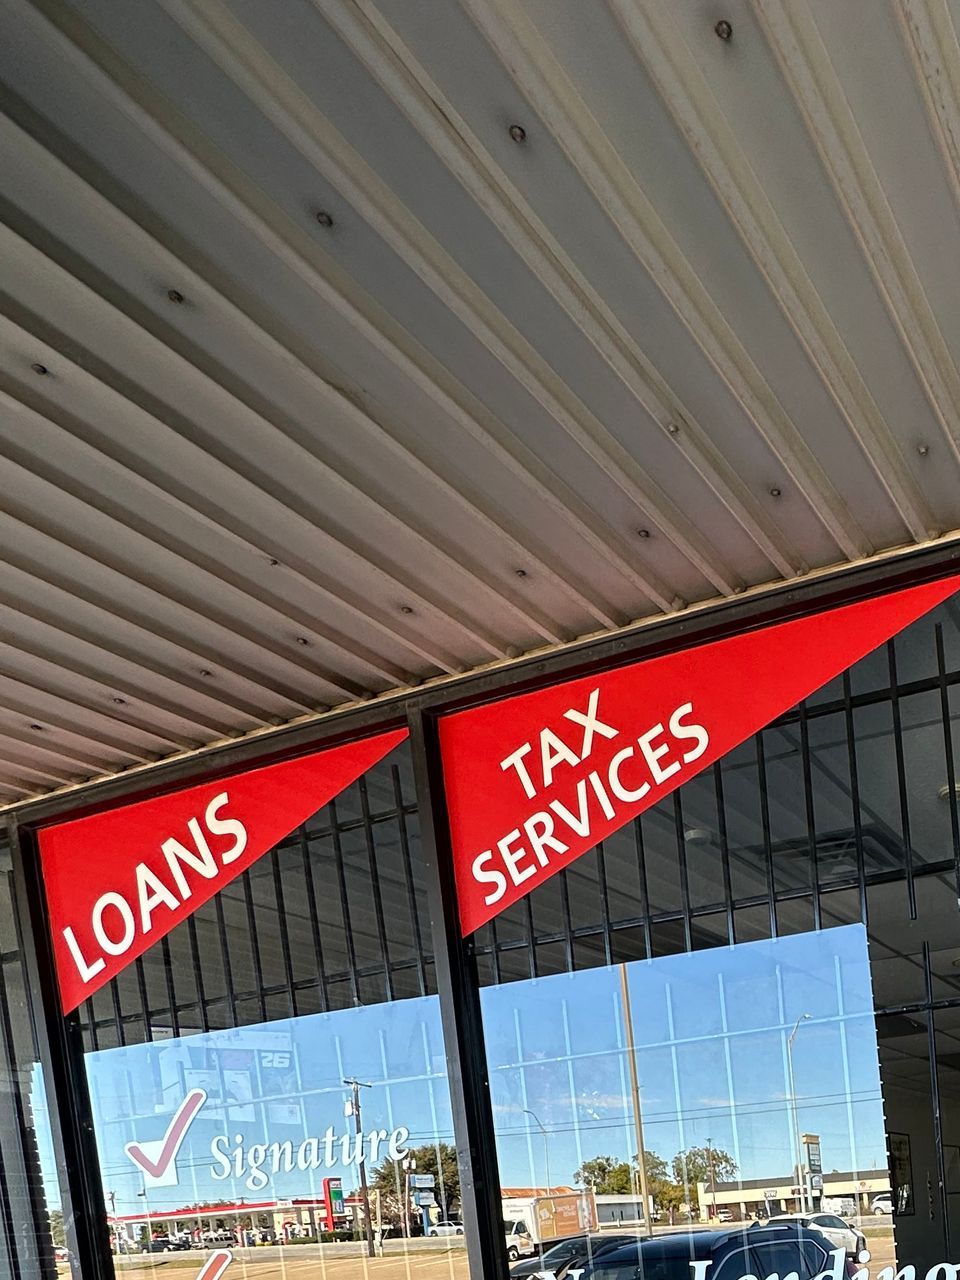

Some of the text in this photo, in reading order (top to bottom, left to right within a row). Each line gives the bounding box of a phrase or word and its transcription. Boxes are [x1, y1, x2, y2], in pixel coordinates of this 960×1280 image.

[470, 701, 710, 906] SERVICES
[500, 687, 619, 799] TAX
[62, 791, 248, 984] LOANS
[209, 1125, 409, 1192] Signature
